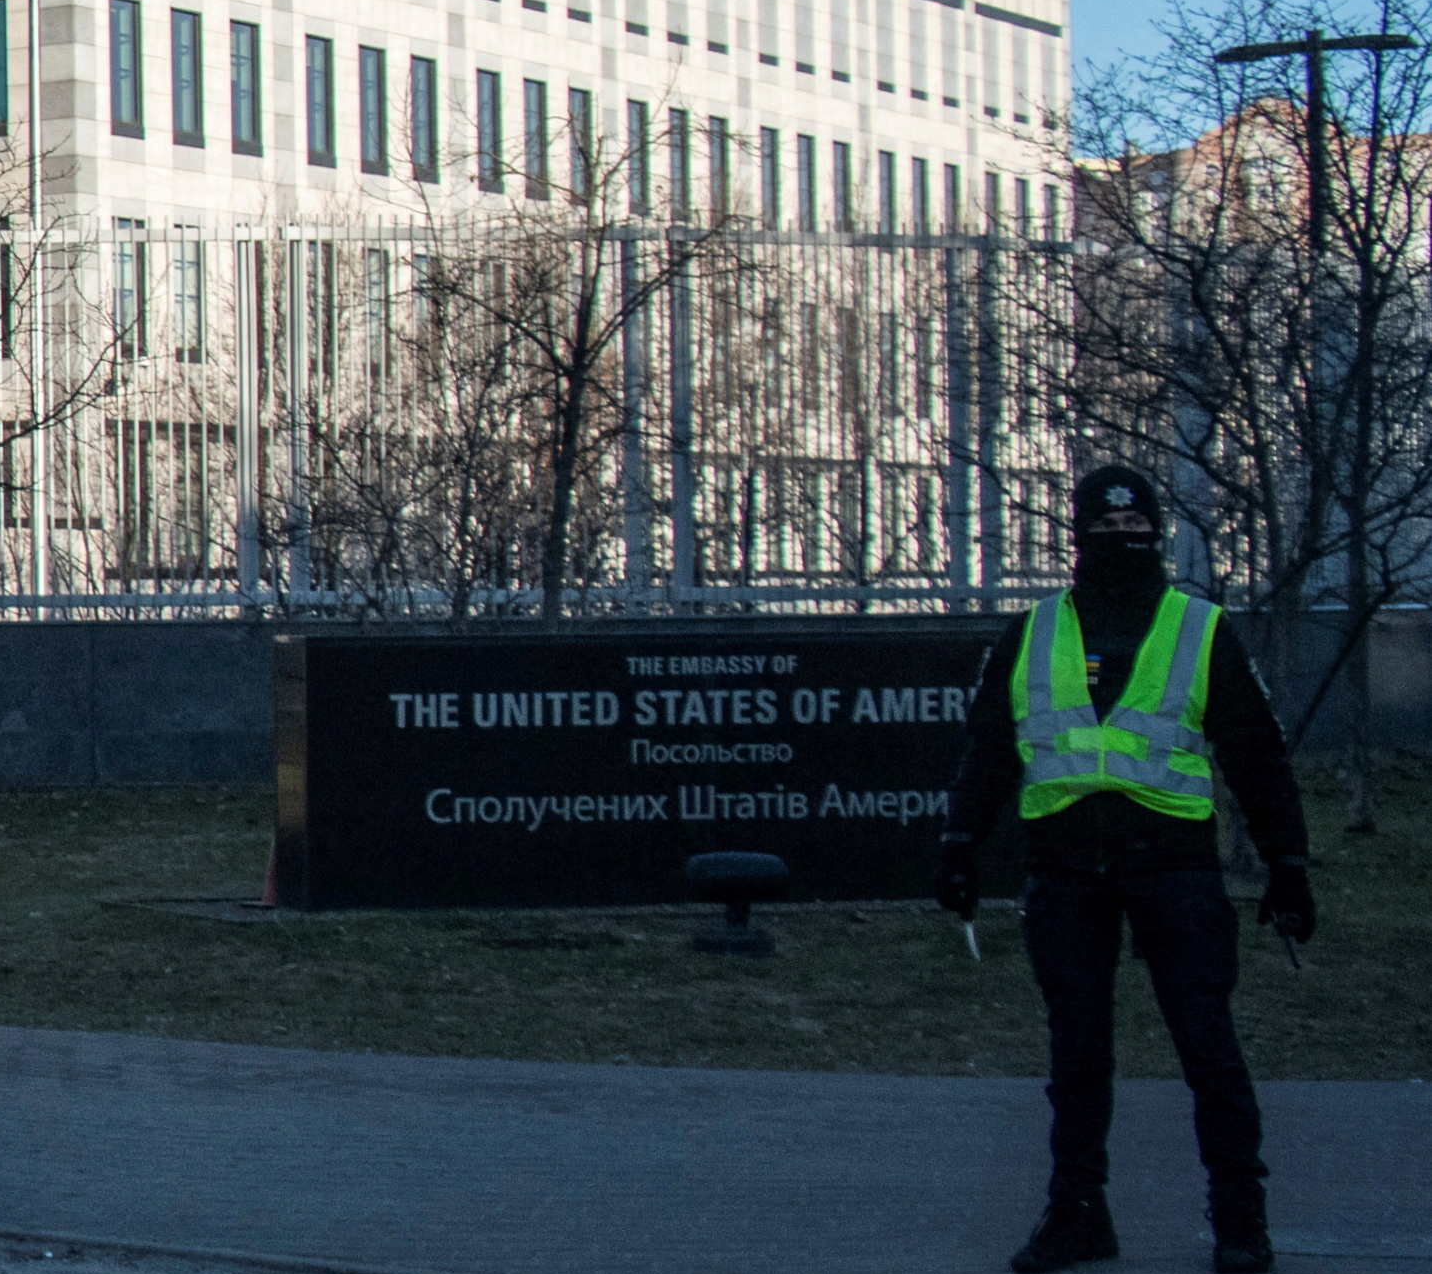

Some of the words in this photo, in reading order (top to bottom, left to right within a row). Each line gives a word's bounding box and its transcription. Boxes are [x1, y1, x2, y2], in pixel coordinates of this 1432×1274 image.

[625, 656, 664, 676] THE
[670, 655, 767, 676] EMBASSY
[771, 654, 799, 675] OF
[388, 692, 460, 729] THE
[472, 690, 621, 728] UNITED
[633, 688, 778, 727] STATES
[791, 687, 841, 725] OF
[630, 737, 795, 765] Посольство
[424, 787, 670, 832] Сполучених
[678, 783, 810, 821] Штатів
